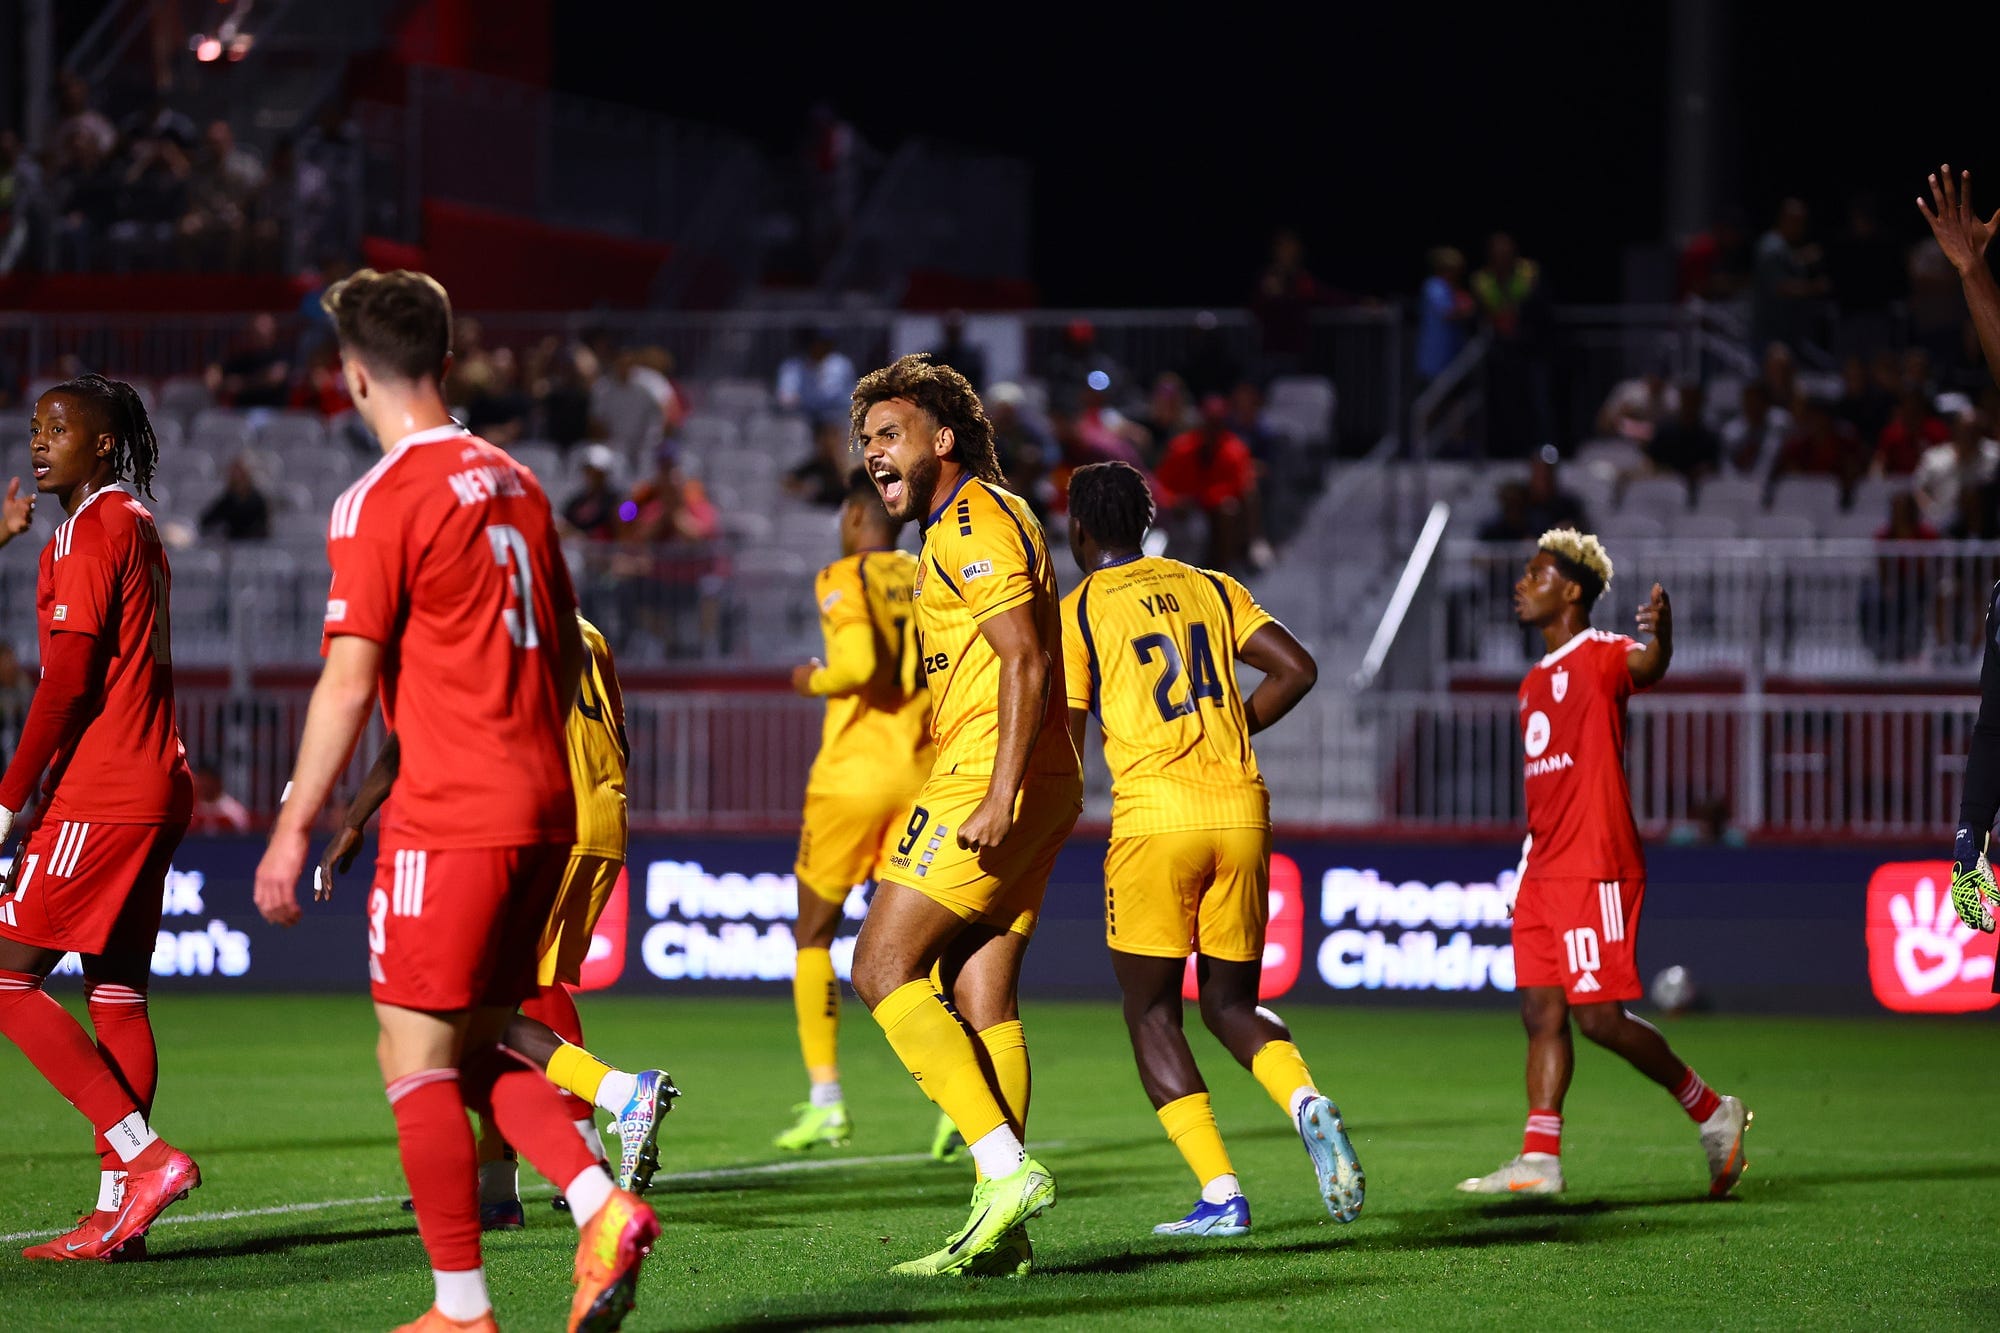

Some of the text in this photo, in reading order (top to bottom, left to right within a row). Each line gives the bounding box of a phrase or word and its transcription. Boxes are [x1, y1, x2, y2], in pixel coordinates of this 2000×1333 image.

[487, 524, 539, 649] 3
[1105, 582, 1133, 595] Rhode
[1139, 593, 1180, 617] YAO
[1131, 622, 1224, 722] 24
[898, 805, 929, 855] 9
[369, 888, 388, 955] 3
[1563, 927, 1600, 974] 10
